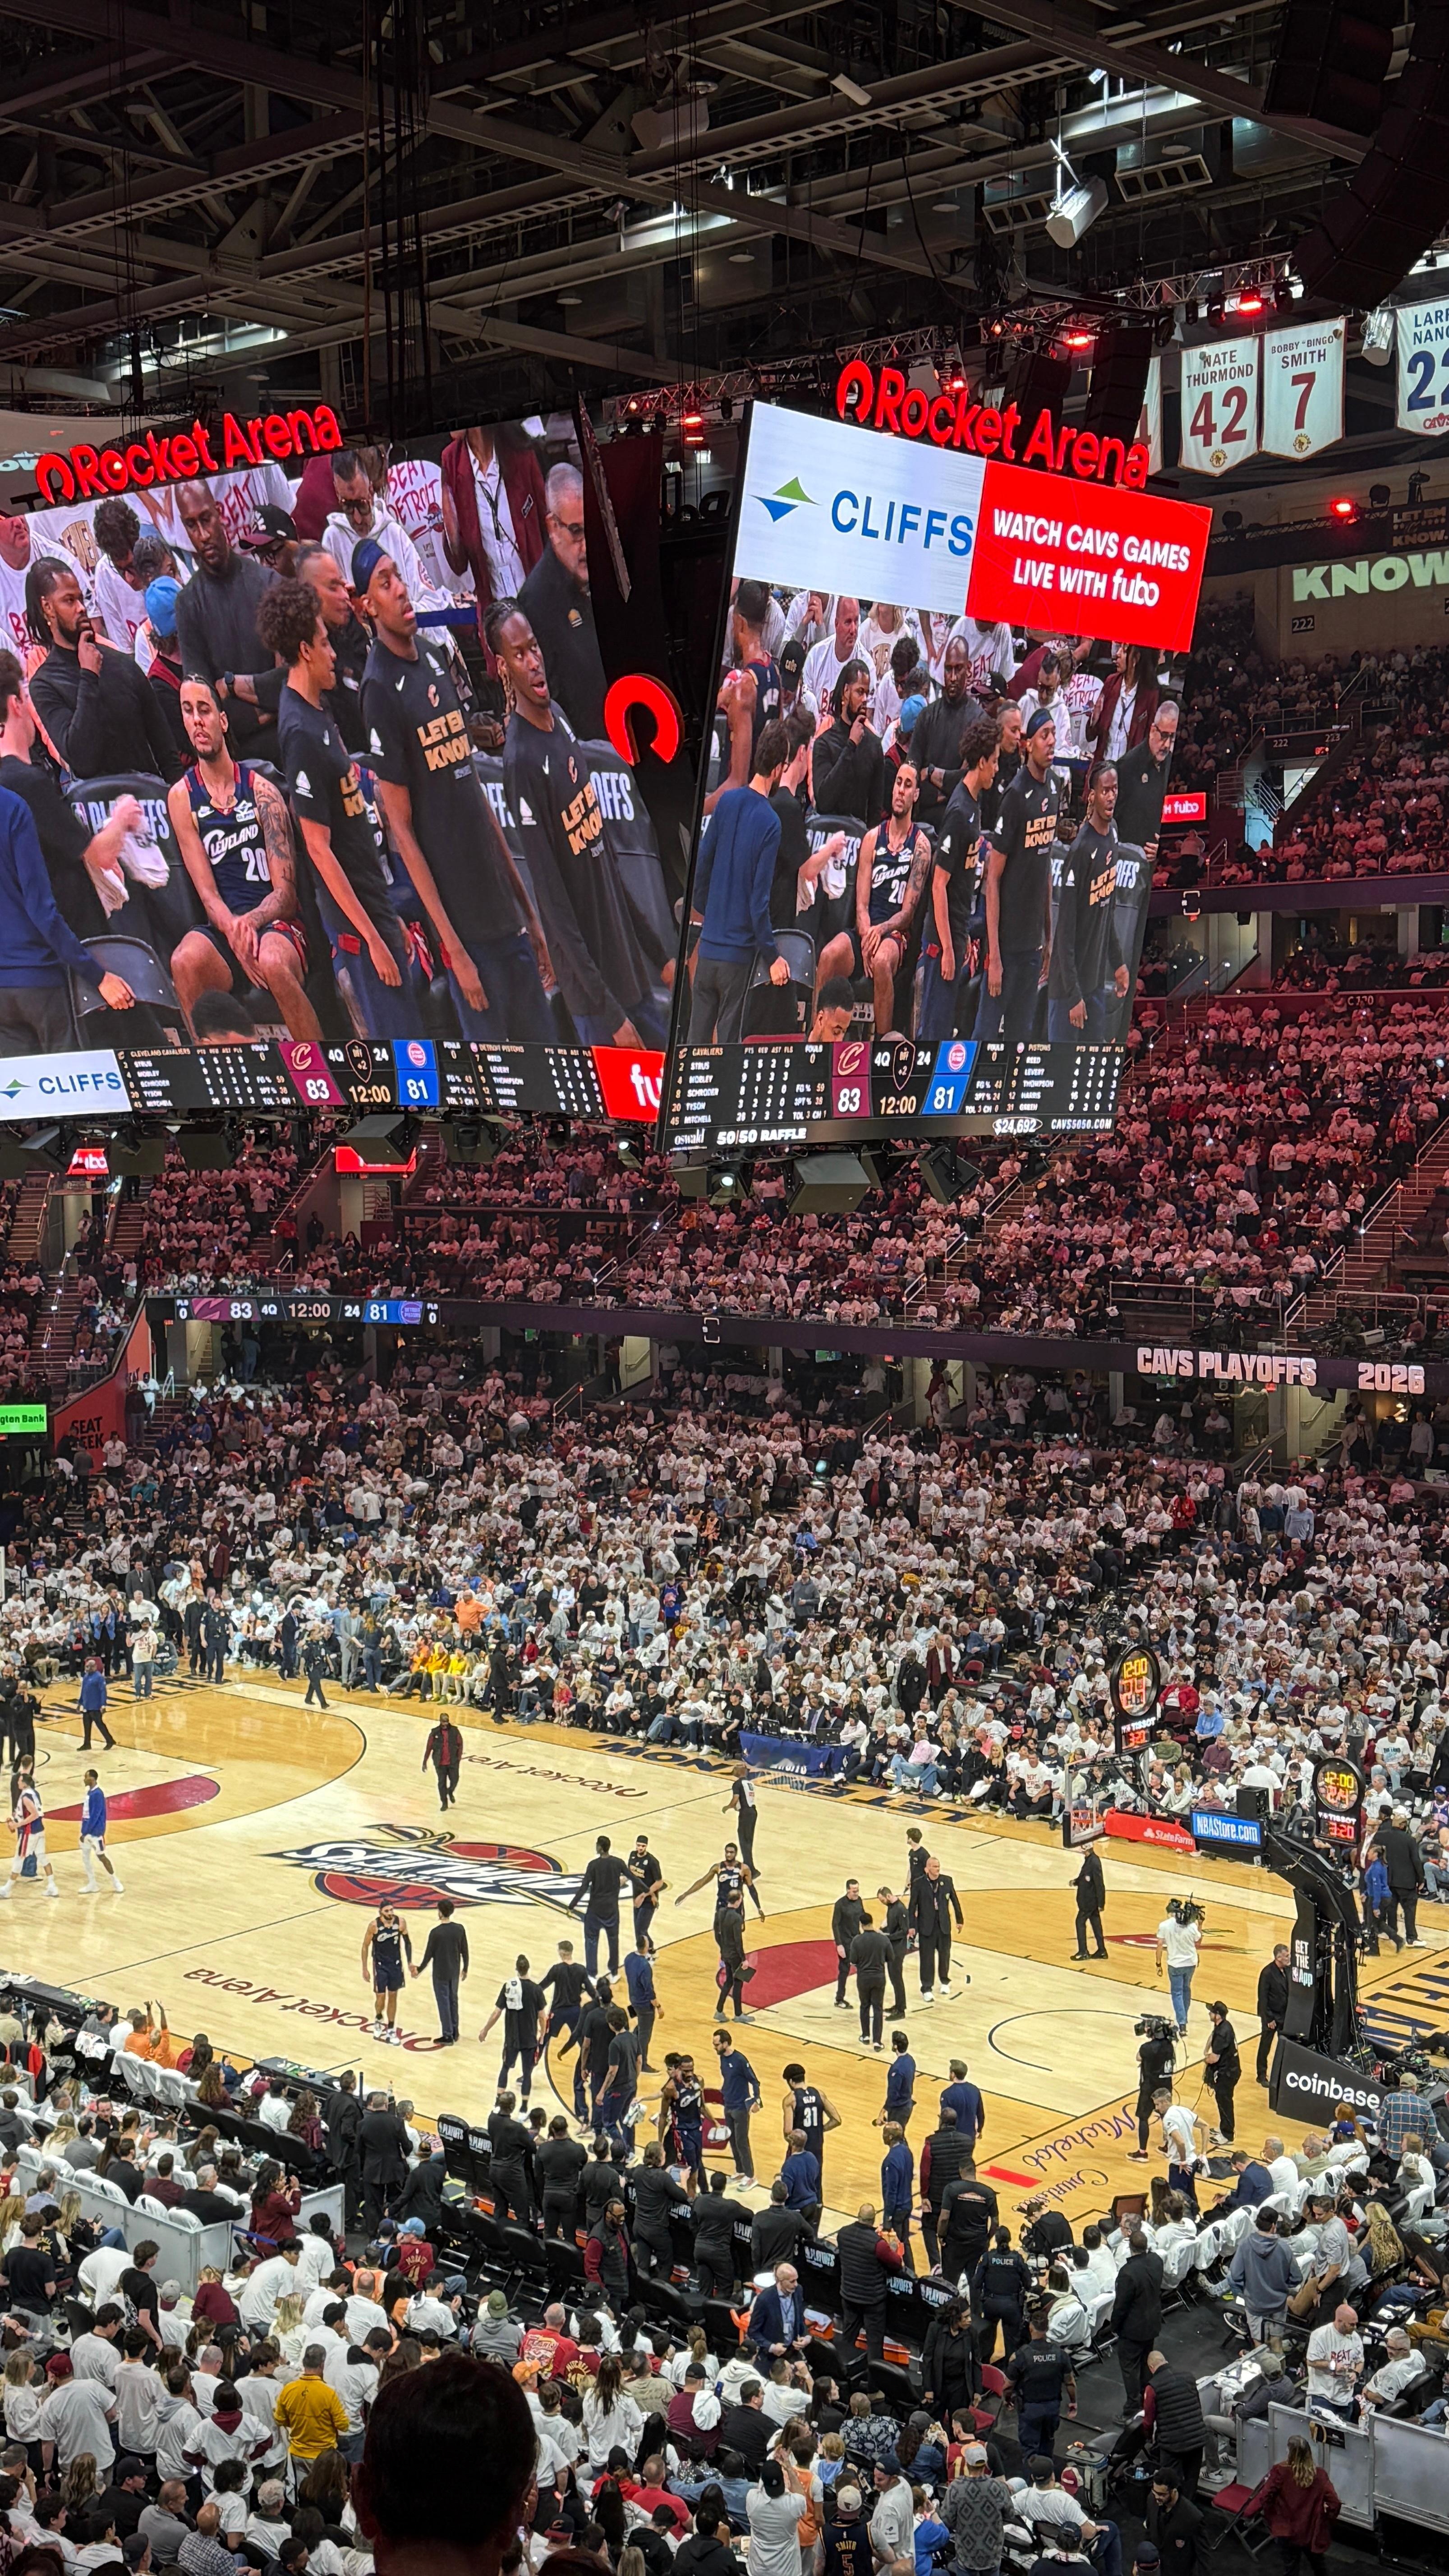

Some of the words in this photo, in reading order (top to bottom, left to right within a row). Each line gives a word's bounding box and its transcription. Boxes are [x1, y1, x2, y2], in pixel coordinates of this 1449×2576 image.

[1271, 341, 1299, 354] BOBBY
[1203, 350, 1237, 368] NATE
[1281, 349, 1326, 369] SMITH
[1187, 363, 1254, 388] THURMOND
[1291, 372, 1316, 430] 7
[1190, 386, 1248, 447] 42
[874, 367, 1022, 459] Rocket
[1024, 409, 1150, 488] Arena
[70, 419, 218, 497] Rocket
[225, 405, 343, 468] Arena
[831, 489, 974, 556] CLIFFS
[1393, 510, 1421, 523] LET
[994, 509, 1062, 547] WATCH
[1067, 524, 1119, 558] CAVS
[1122, 538, 1191, 571] GAMES
[1393, 530, 1448, 547] KNOW.
[1013, 558, 1055, 590] LIVE
[1059, 565, 1106, 598] WITH
[1111, 569, 1159, 607] fubo
[1293, 617, 1314, 631] 222
[417, 715, 446, 747] LET
[1273, 739, 1288, 748] 222
[561, 795, 586, 831] LET
[1173, 800, 1200, 815] fubo
[1026, 817, 1046, 833] LET
[242, 848, 271, 881] 20
[888, 879, 906, 904] 20
[328, 1049, 345, 1062] 4Q
[373, 1048, 389, 1061] 24
[874, 1052, 890, 1067] 4Q
[917, 1051, 931, 1066] 24
[39, 1072, 122, 1094] CLIFFS
[306, 1079, 329, 1099] 83
[407, 1079, 428, 1099] 81
[349, 1085, 391, 1103] 12:00
[838, 1088, 860, 1112] 83
[934, 1086, 955, 1109] 81
[880, 1096, 916, 1115] 12:00
[1051, 1118, 1112, 1129] CAVS5050.COM
[717, 1129, 758, 1145] 50/50
[760, 1128, 807, 1141] RAFFLE
[230, 1302, 252, 1319] 83
[262, 1305, 277, 1315] 4Q
[289, 1303, 330, 1317] 12:00
[344, 1305, 360, 1316] 24
[370, 1304, 387, 1320] 81
[1136, 1348, 1194, 1377] CAVS
[1198, 1351, 1317, 1386] PLAYOFFS
[1358, 1362, 1425, 1394] 2026
[22, 1415, 44, 1423] Bank
[71, 1417, 103, 1434] SEAT
[1124, 1658, 1148, 1678] 12:00
[1132, 1716, 1157, 1730] TISSOT
[458, 1754, 516, 1774] Are
[592, 1739, 736, 1774] NOW.
[1329, 1815, 1357, 1824] TISSOT
[1196, 1819, 1258, 1843] NBAStore.com
[1295, 1939, 1309, 1954] GET
[1295, 1955, 1310, 1969] THE
[183, 1969, 294, 2004] Arena
[1299, 1969, 1313, 1987] App
[1286, 2071, 1380, 2109] coinbase
[803, 2107, 817, 2127] 31
[1033, 2354, 1056, 2363] POLICE
[842, 2554, 854, 2576] 5
